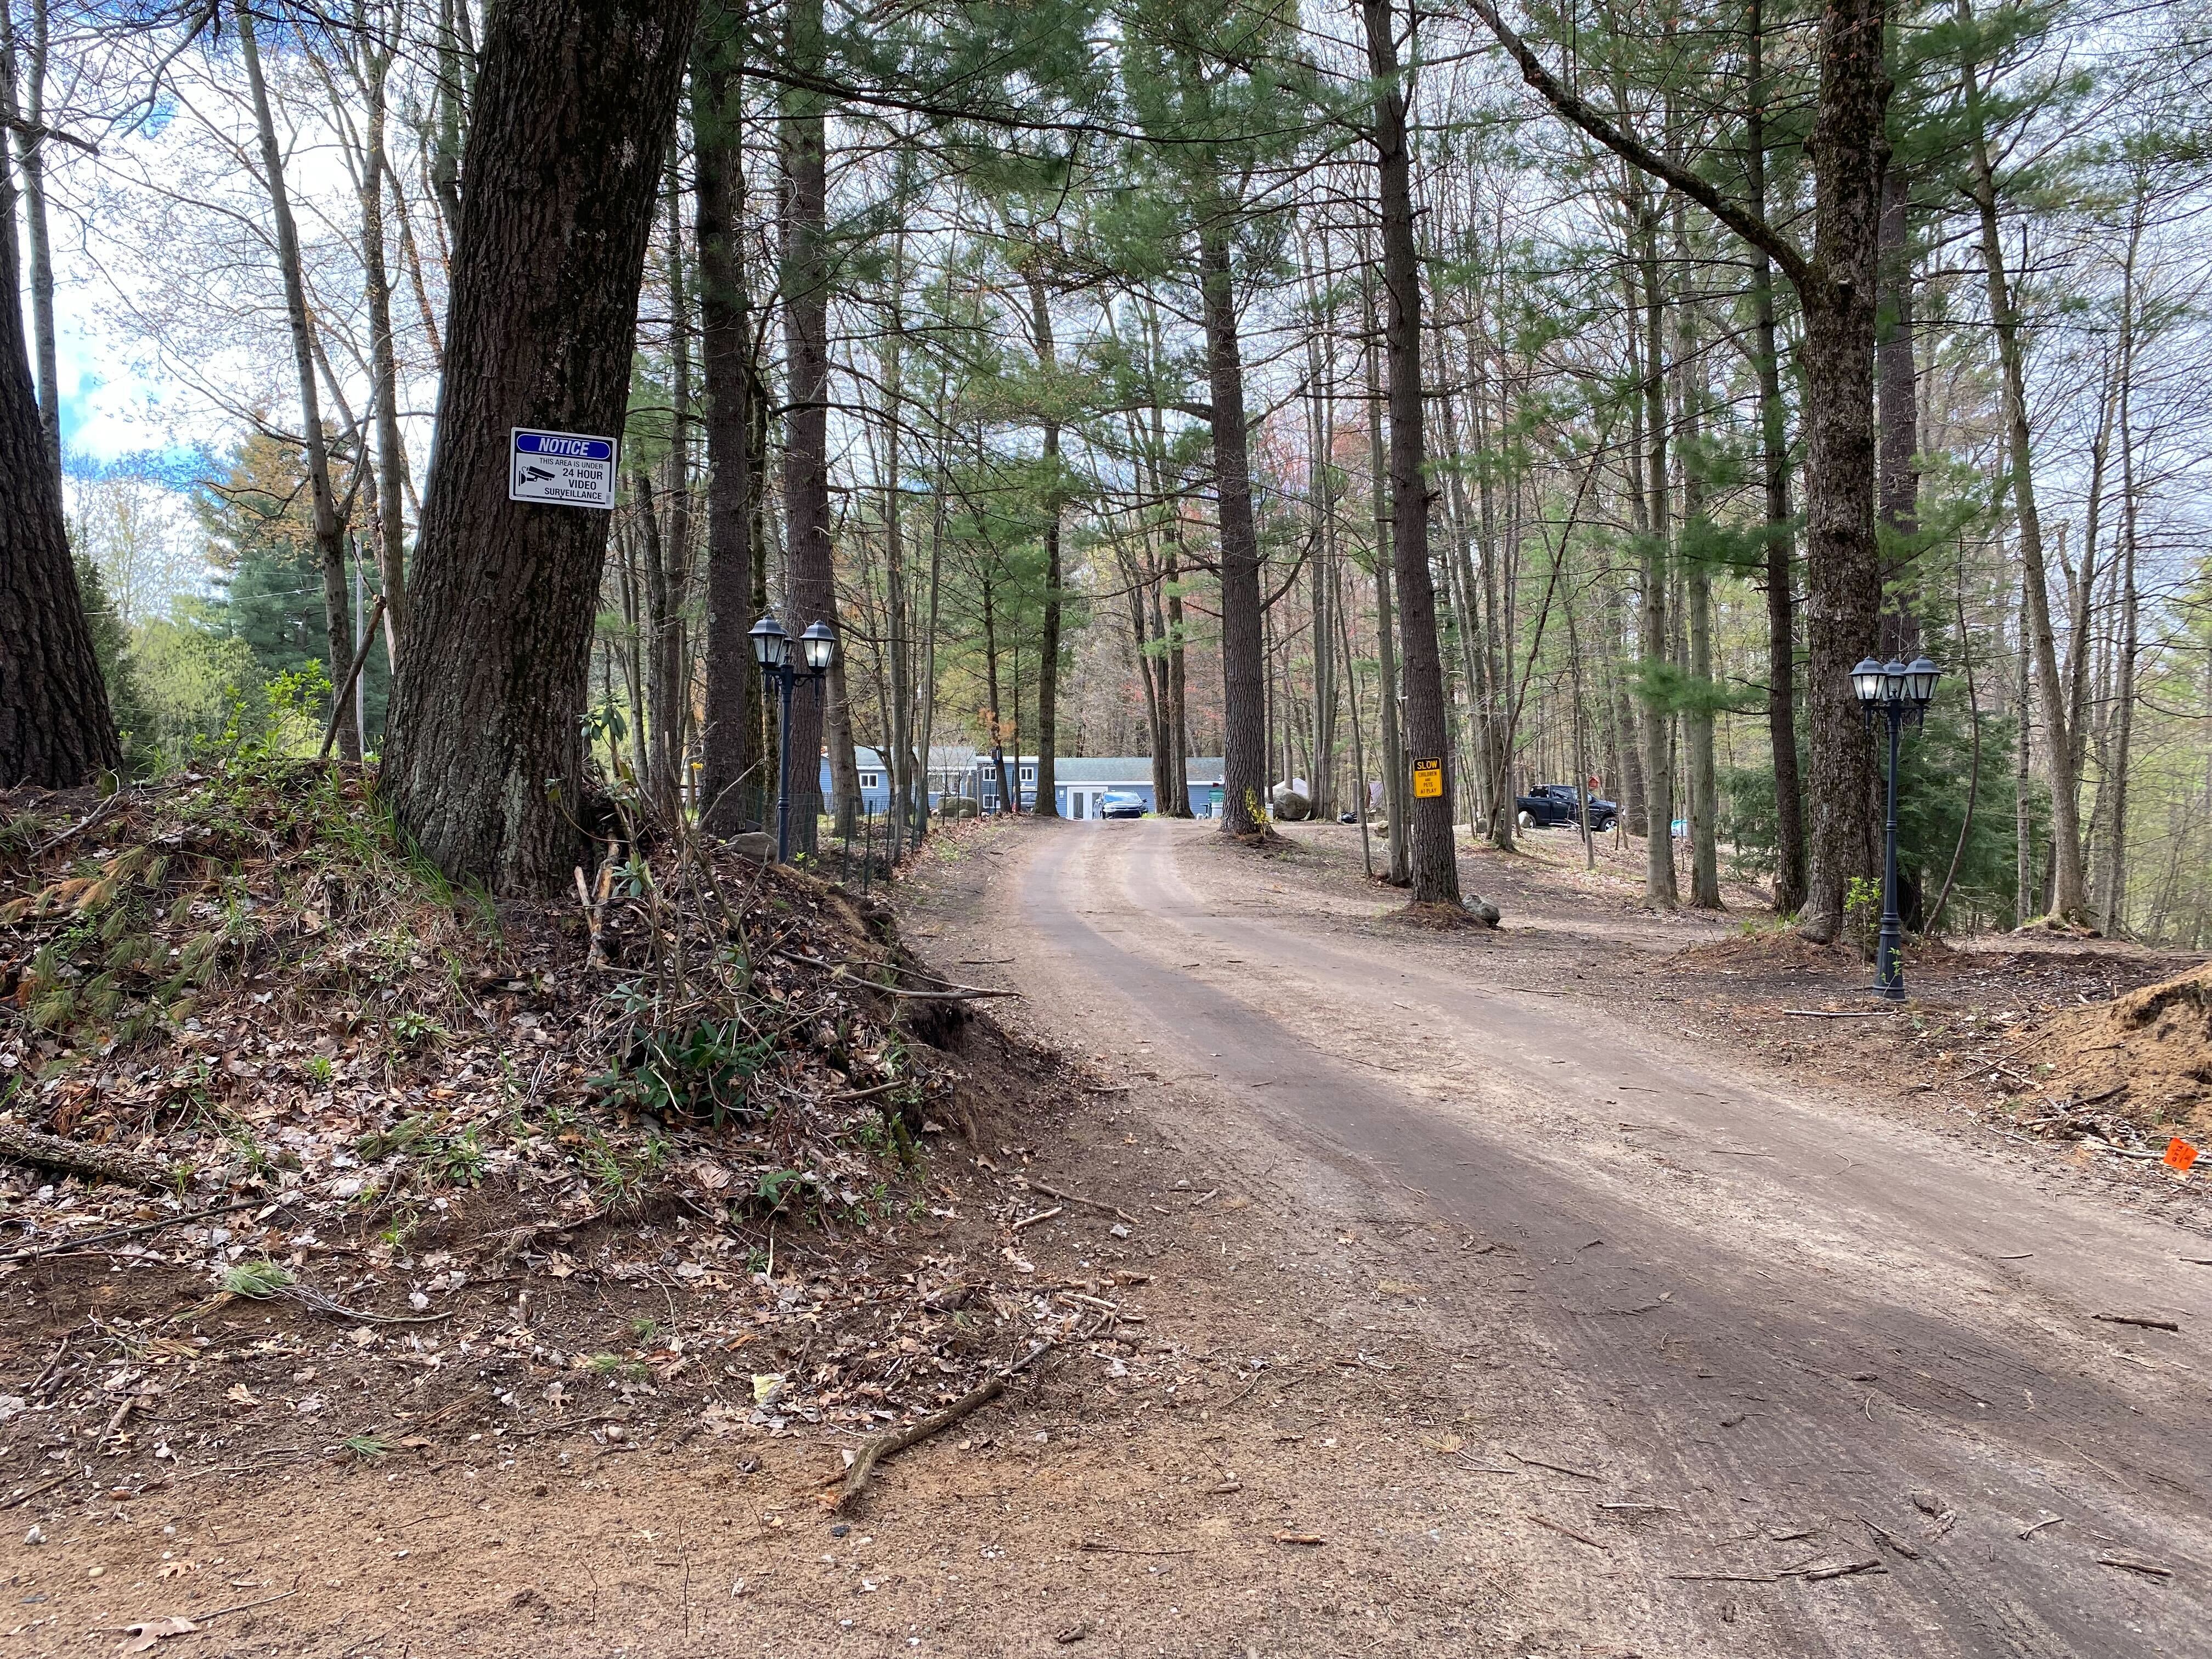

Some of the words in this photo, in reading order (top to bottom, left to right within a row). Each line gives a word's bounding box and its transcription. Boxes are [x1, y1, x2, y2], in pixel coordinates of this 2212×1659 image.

[538, 437, 590, 456] NOTICE
[562, 468, 574, 477] 24
[577, 469, 603, 480] HOUR
[568, 479, 596, 490] VIDEO
[544, 487, 602, 500] SURVEILLANCE
[1417, 760, 1437, 770] SLOW
